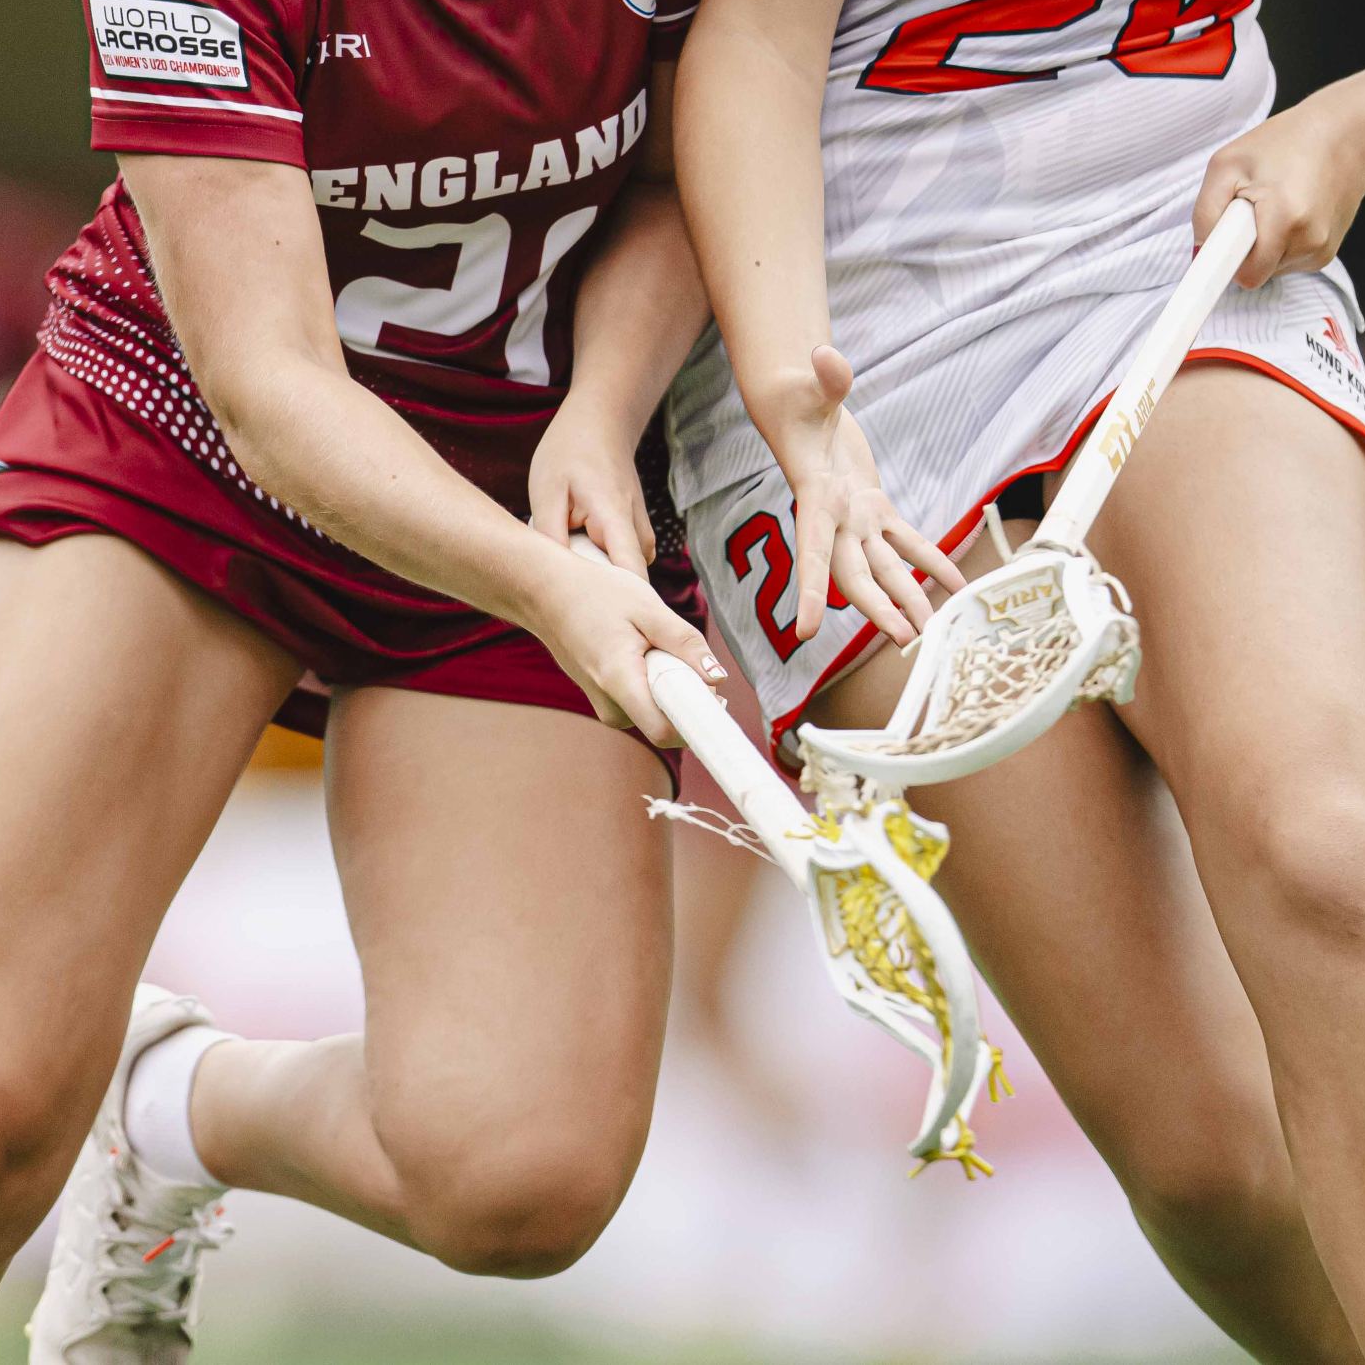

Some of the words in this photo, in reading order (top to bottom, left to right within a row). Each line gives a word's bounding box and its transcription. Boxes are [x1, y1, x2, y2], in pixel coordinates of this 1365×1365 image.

[103, 5, 212, 35] WORLD
[95, 27, 238, 60] LACROSSE
[114, 55, 148, 69] WOMEN'S
[150, 58, 168, 71] U20
[169, 61, 241, 79] CHAMPIONSHIP
[311, 88, 647, 211] ENGLAND
[1305, 332, 1342, 374] HONG
[993, 586, 1053, 614] ARIA
